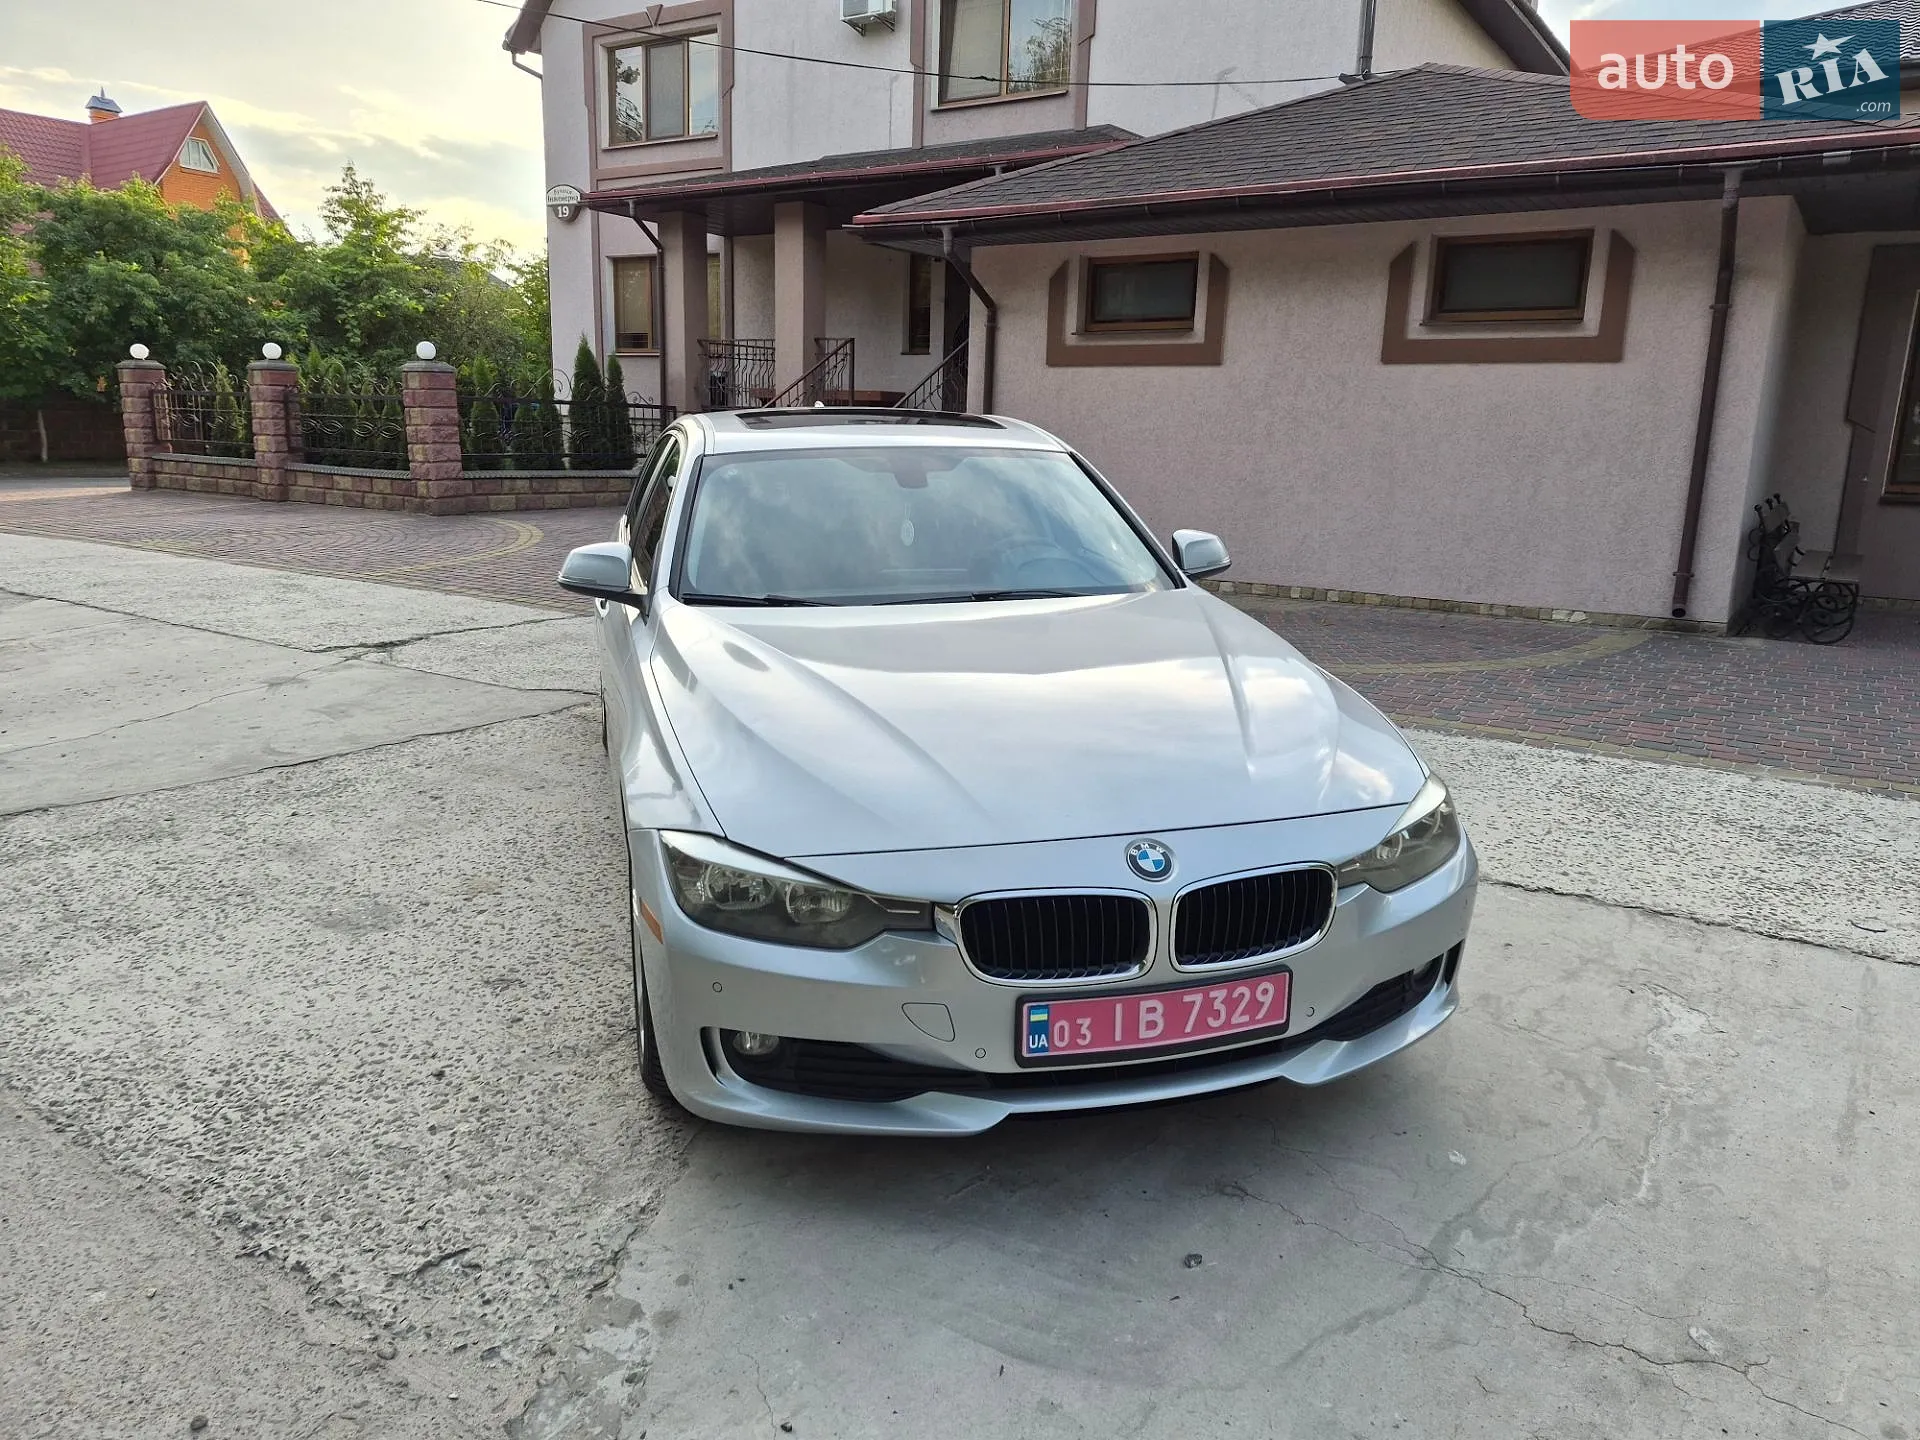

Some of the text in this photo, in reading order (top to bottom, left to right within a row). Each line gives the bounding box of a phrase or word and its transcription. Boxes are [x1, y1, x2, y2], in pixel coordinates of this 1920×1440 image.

[557, 205, 569, 218] 19
[1130, 843, 1165, 856] BMW
[1053, 1017, 1092, 1048] 03
[1182, 981, 1275, 1033] 7329
[1029, 1034, 1048, 1049] UA
